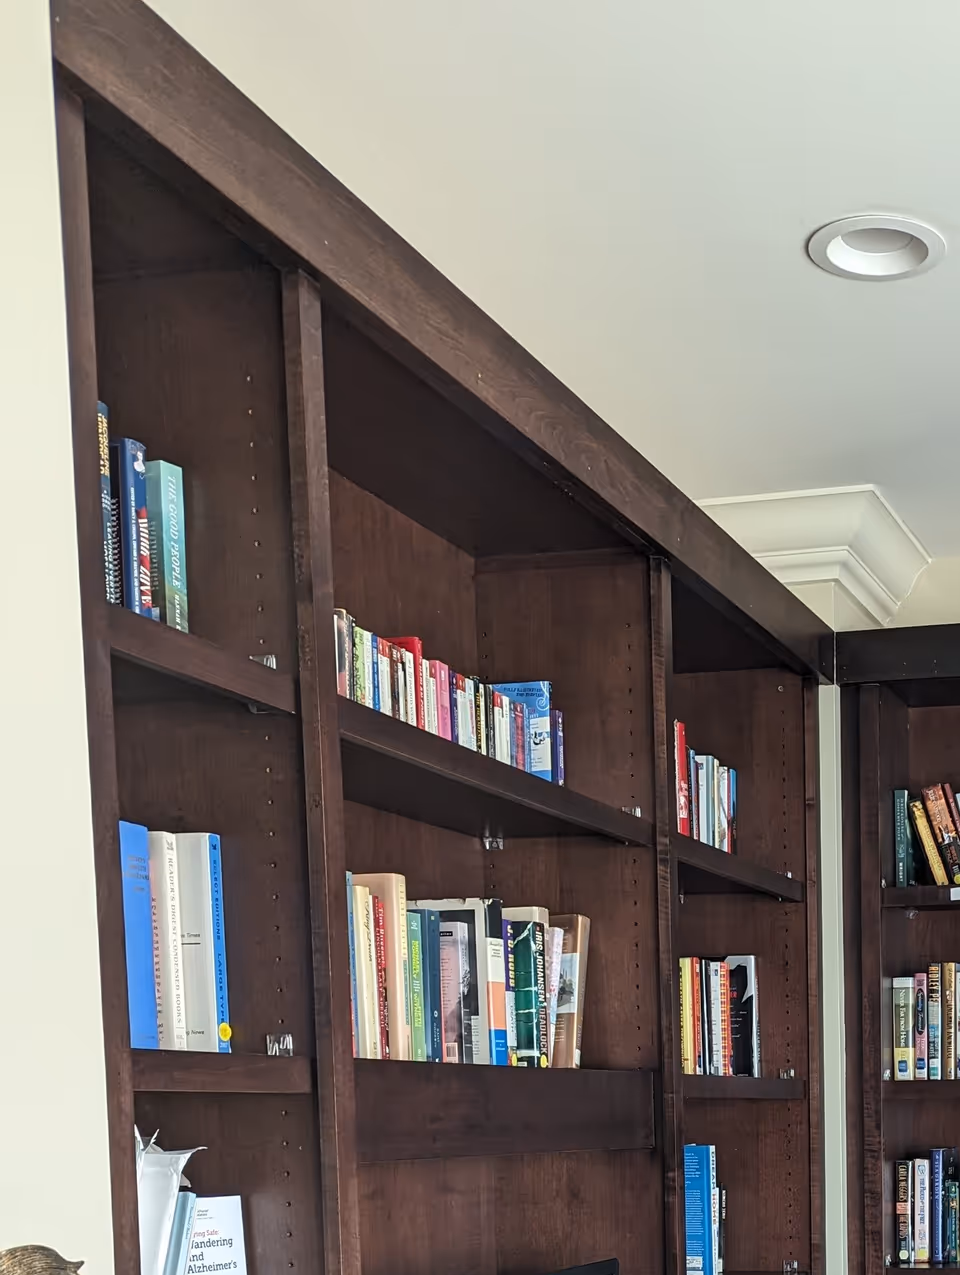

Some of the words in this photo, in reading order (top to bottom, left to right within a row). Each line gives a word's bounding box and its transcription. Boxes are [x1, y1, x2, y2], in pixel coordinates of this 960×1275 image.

[166, 476, 177, 501] THE
[168, 505, 179, 540] GOOD
[170, 543, 181, 588] PEOPLE
[507, 925, 514, 936] J.
[535, 931, 543, 950] IRIS
[536, 953, 546, 1001] JOHANSEN
[928, 966, 939, 990] RIDLEY
[540, 1008, 548, 1053] DEADLOCK
[187, 1259, 237, 1274] Alzheimer's
